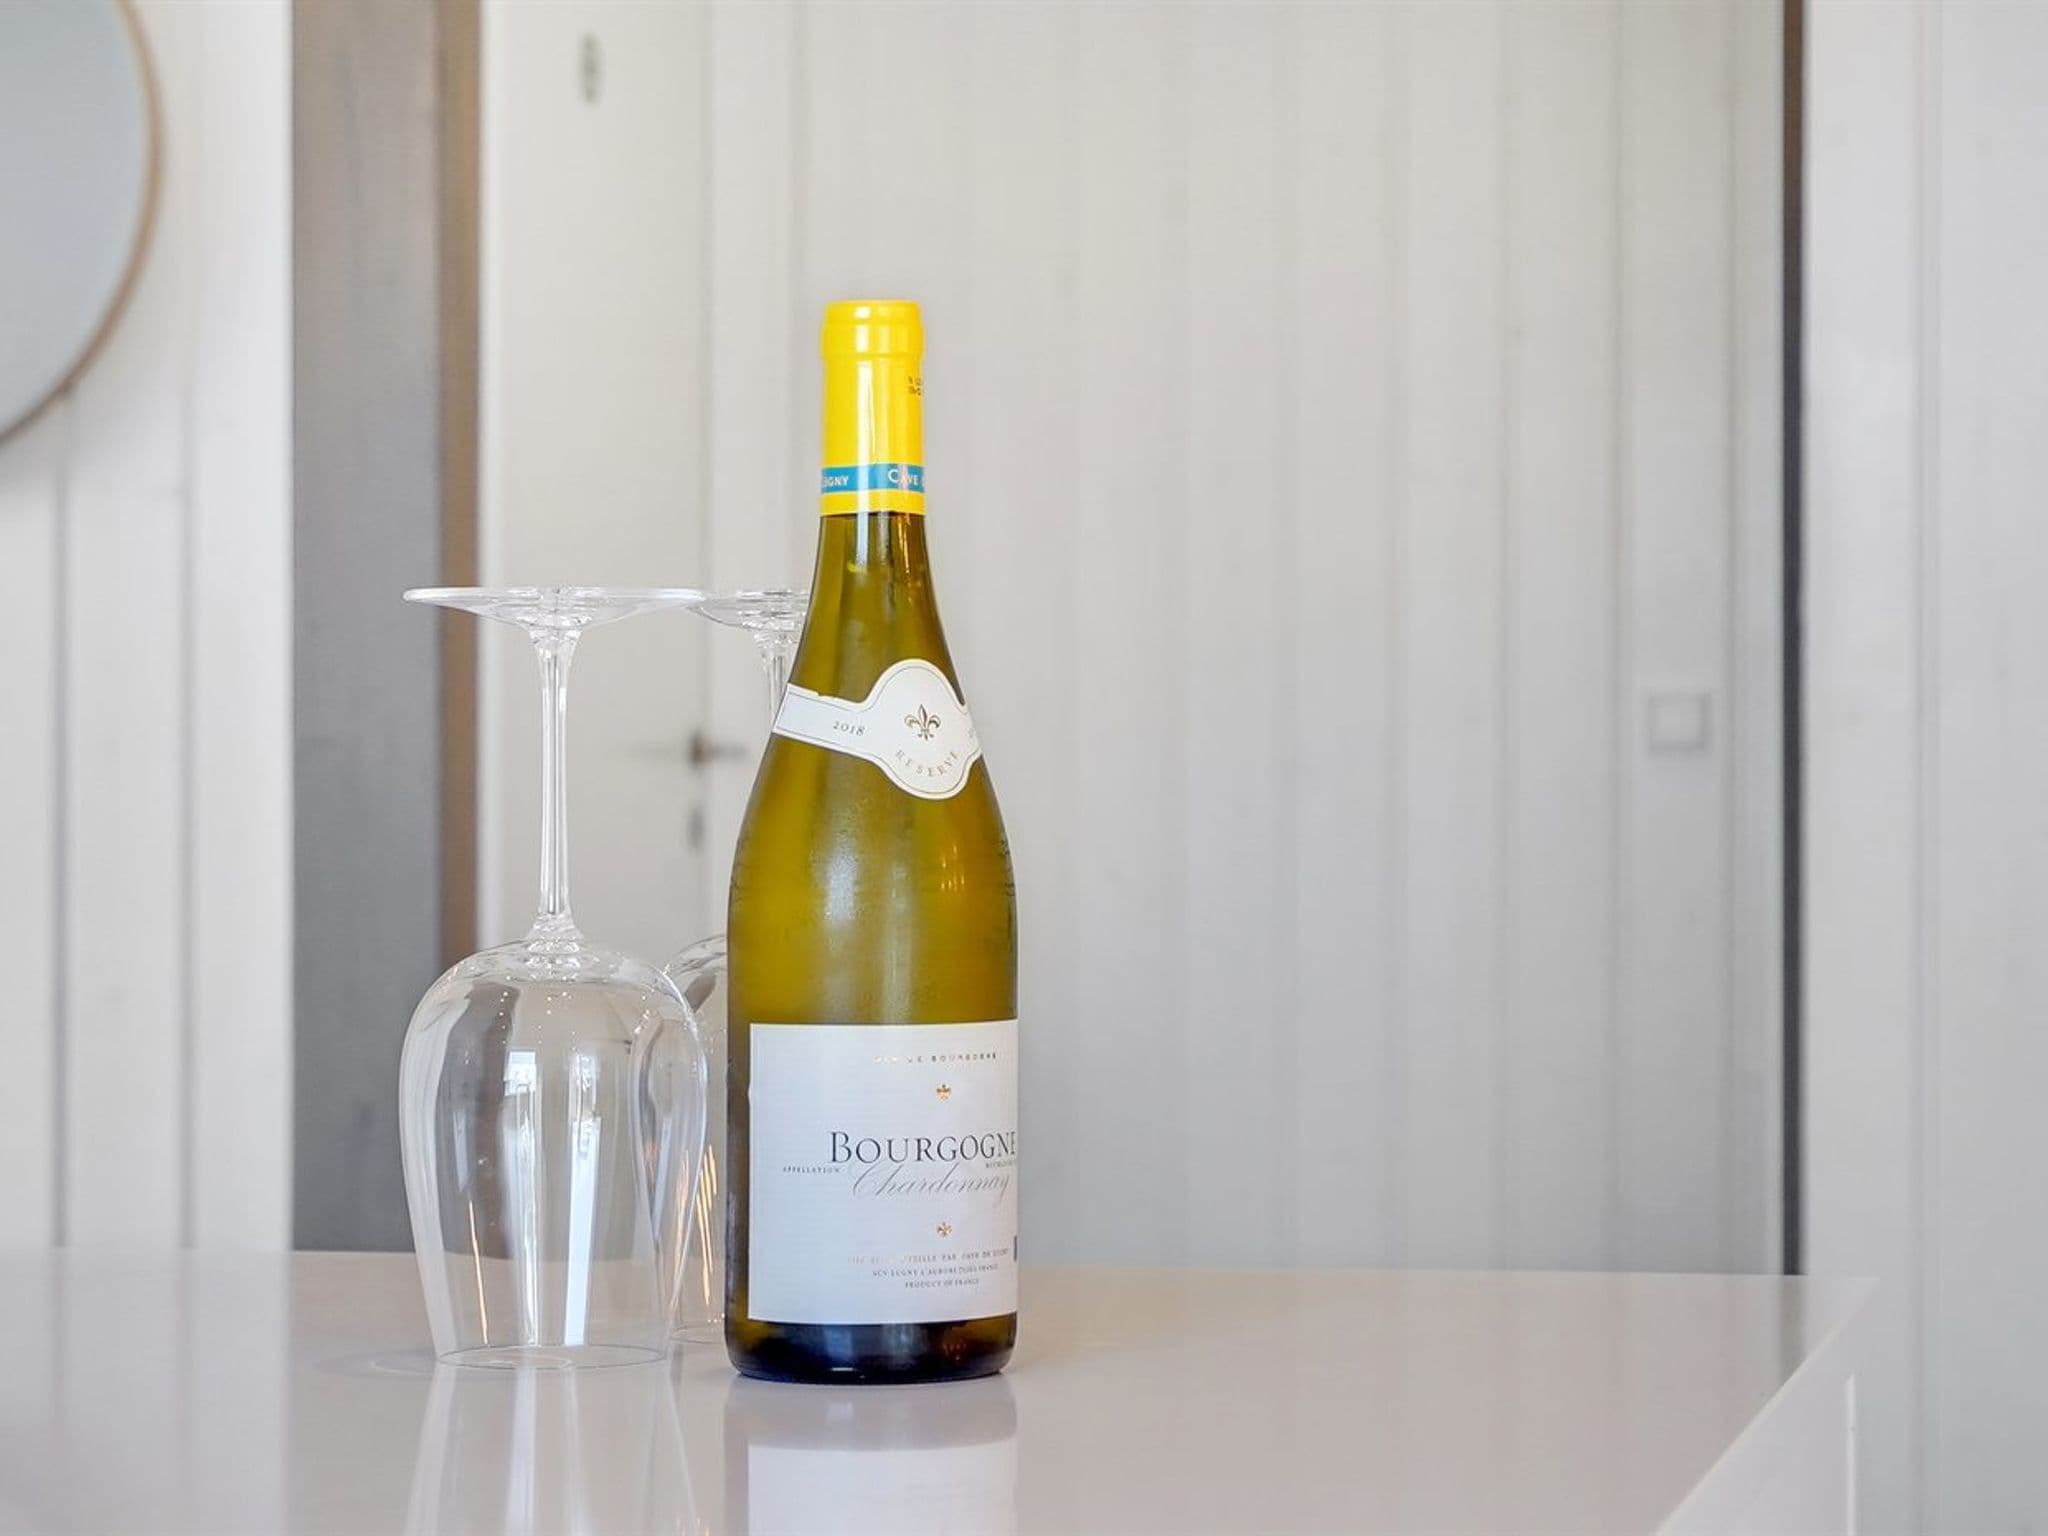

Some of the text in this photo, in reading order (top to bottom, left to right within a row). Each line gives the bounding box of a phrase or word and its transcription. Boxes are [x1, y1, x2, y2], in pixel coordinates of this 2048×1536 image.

[833, 720, 866, 736] 2018
[895, 750, 960, 777] RESERVE
[830, 1130, 1017, 1165] BOURGOGNE
[852, 1162, 1010, 1200] Chardonnay
